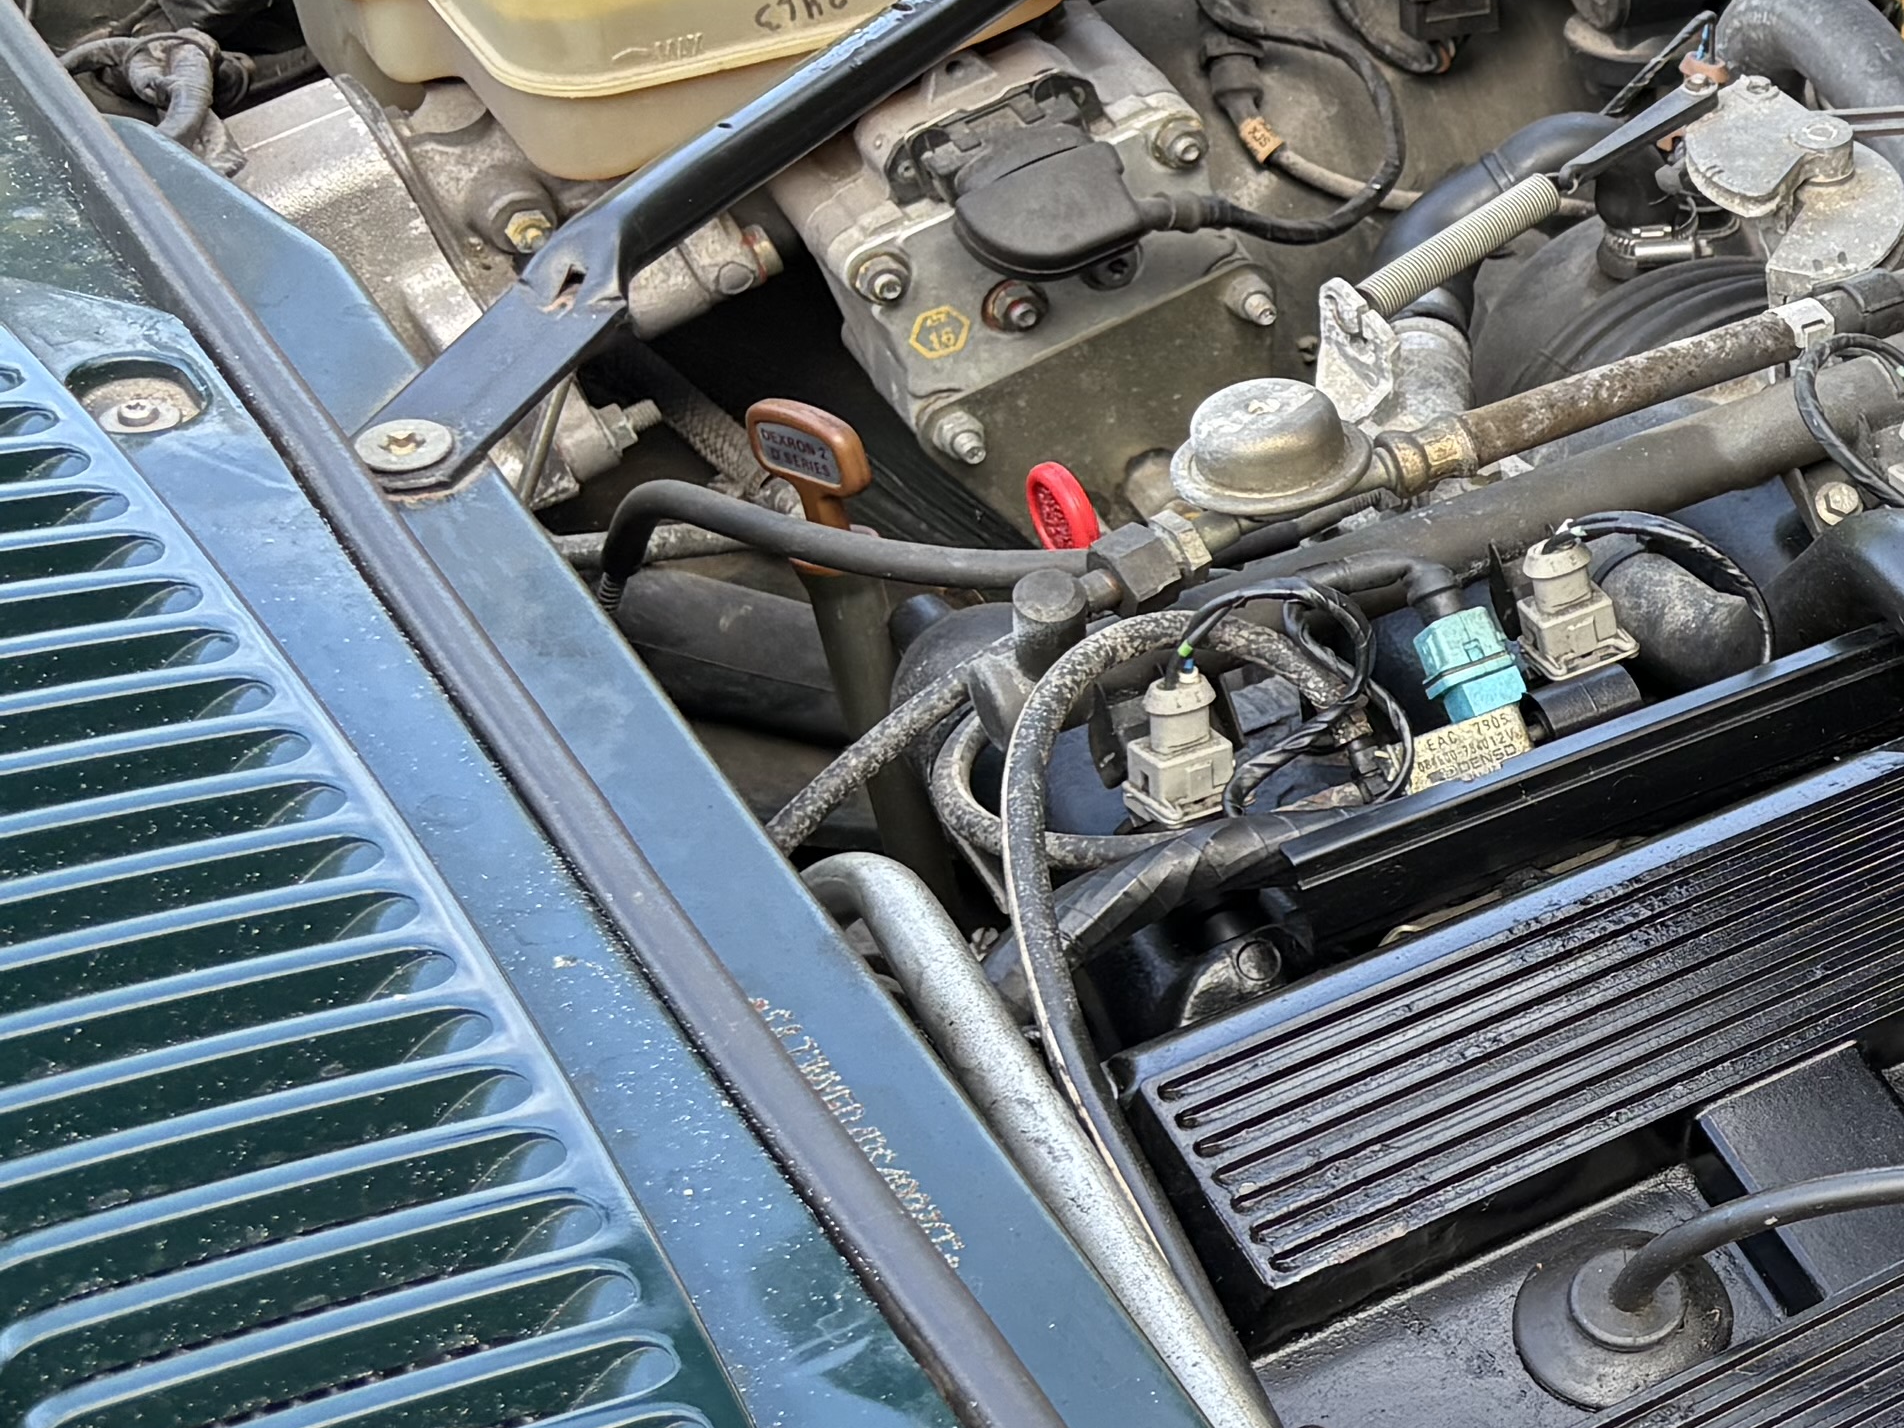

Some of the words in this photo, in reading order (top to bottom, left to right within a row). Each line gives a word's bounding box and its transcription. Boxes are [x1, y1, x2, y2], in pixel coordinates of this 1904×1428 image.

[760, 428, 816, 456] DEXRON
[818, 446, 829, 460] 2
[783, 452, 831, 477] SERIES
[1426, 730, 1458, 752] EAC
[1473, 712, 1511, 736] 7905
